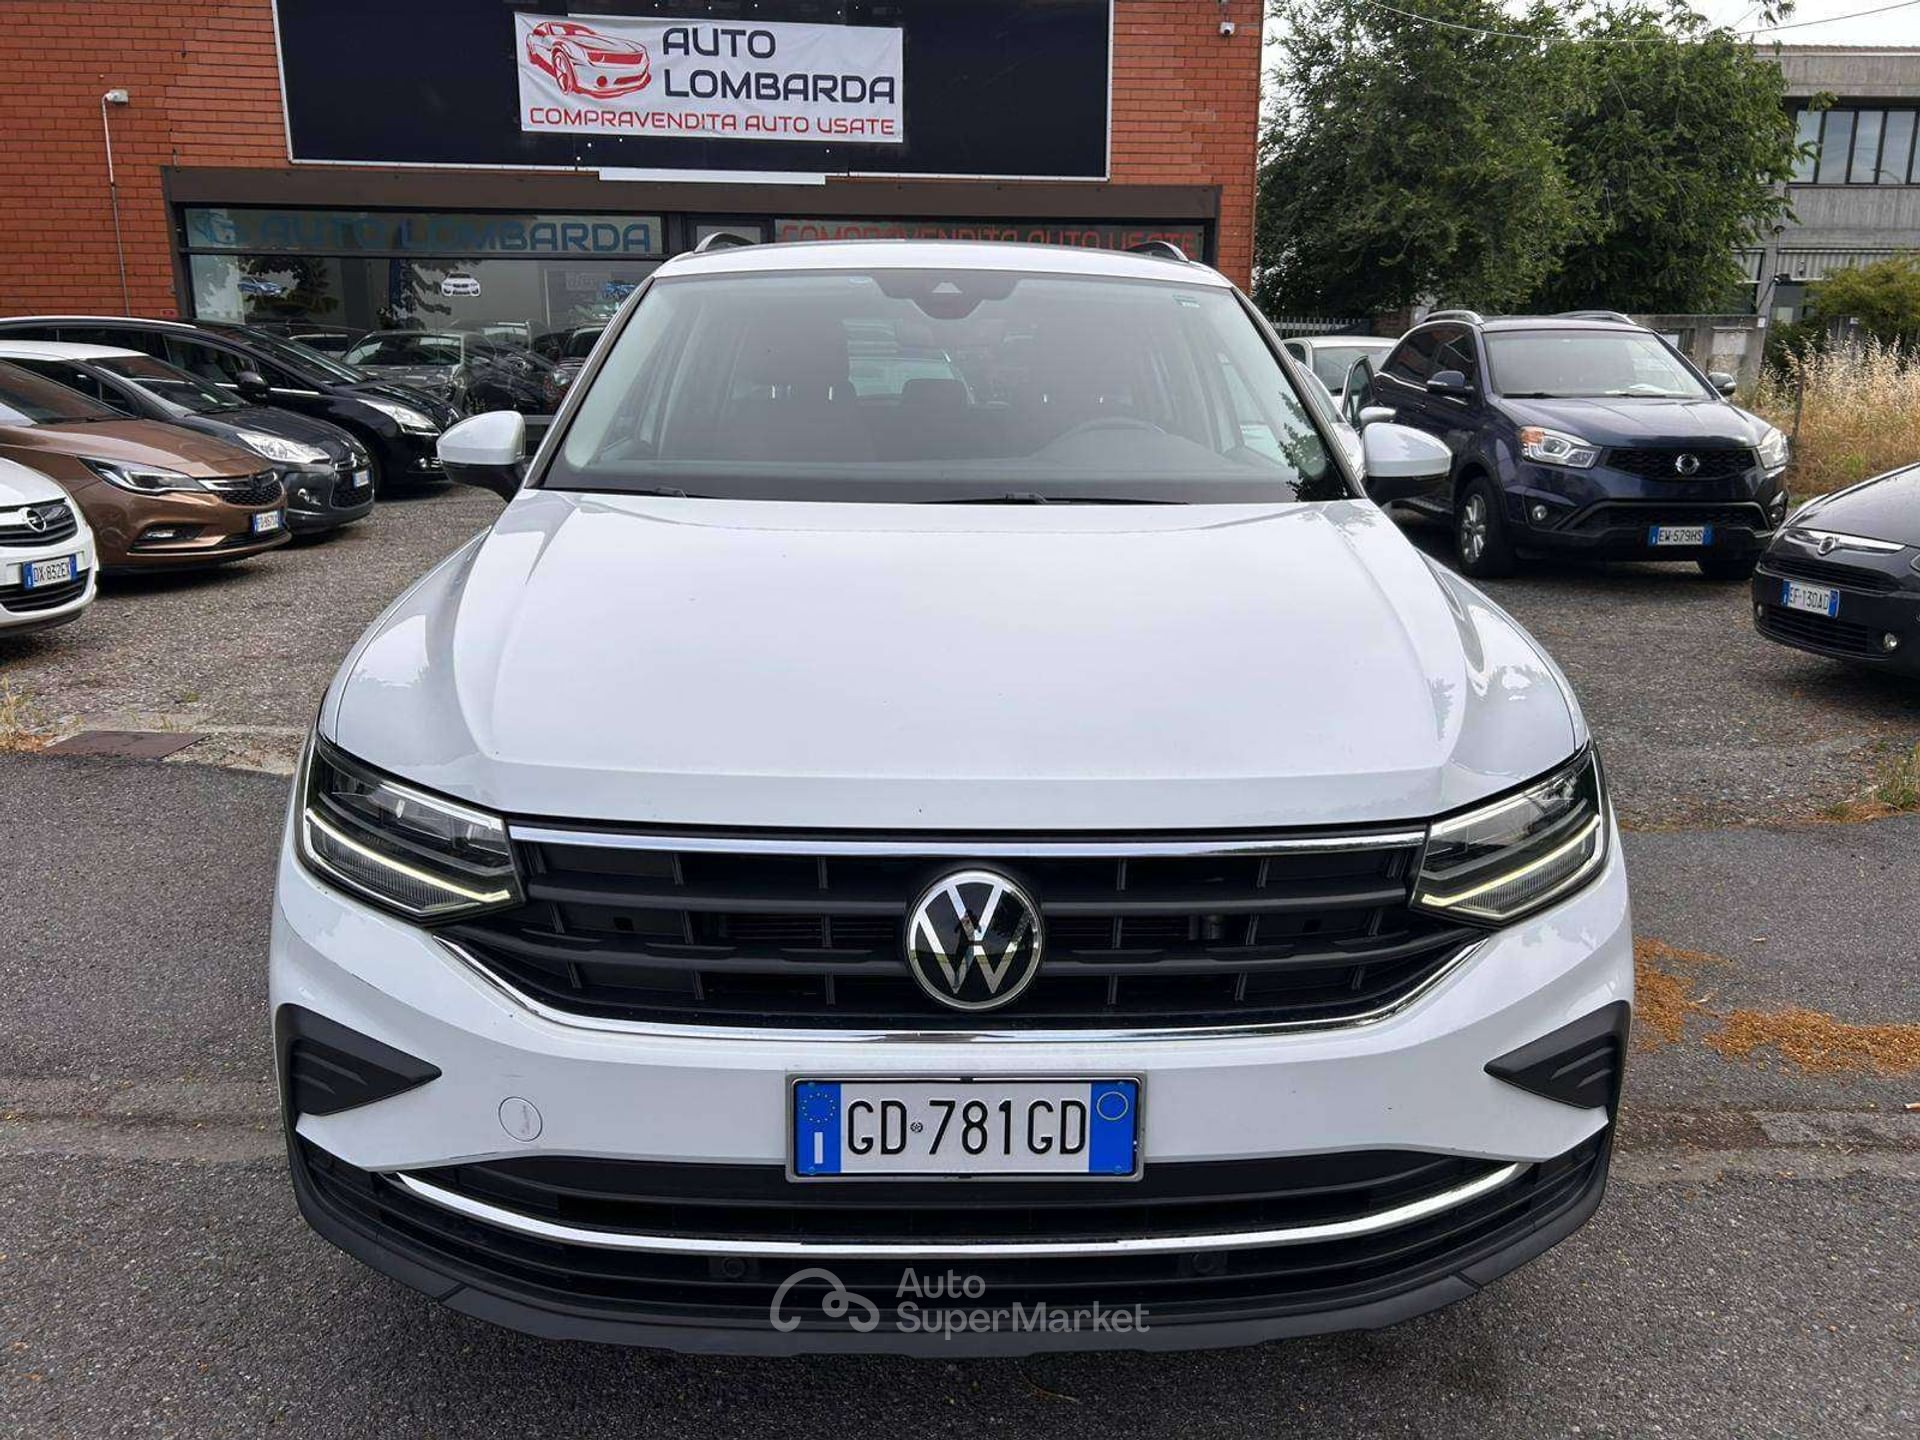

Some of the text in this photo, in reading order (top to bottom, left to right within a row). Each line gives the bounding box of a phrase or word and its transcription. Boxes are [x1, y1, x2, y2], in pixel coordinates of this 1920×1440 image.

[662, 27, 776, 59] AUTO
[663, 69, 896, 104] LOMBARDA
[529, 107, 896, 135] COMPRAVENDITA AUTO USATE
[259, 216, 651, 252] AUTO LOMBARDA
